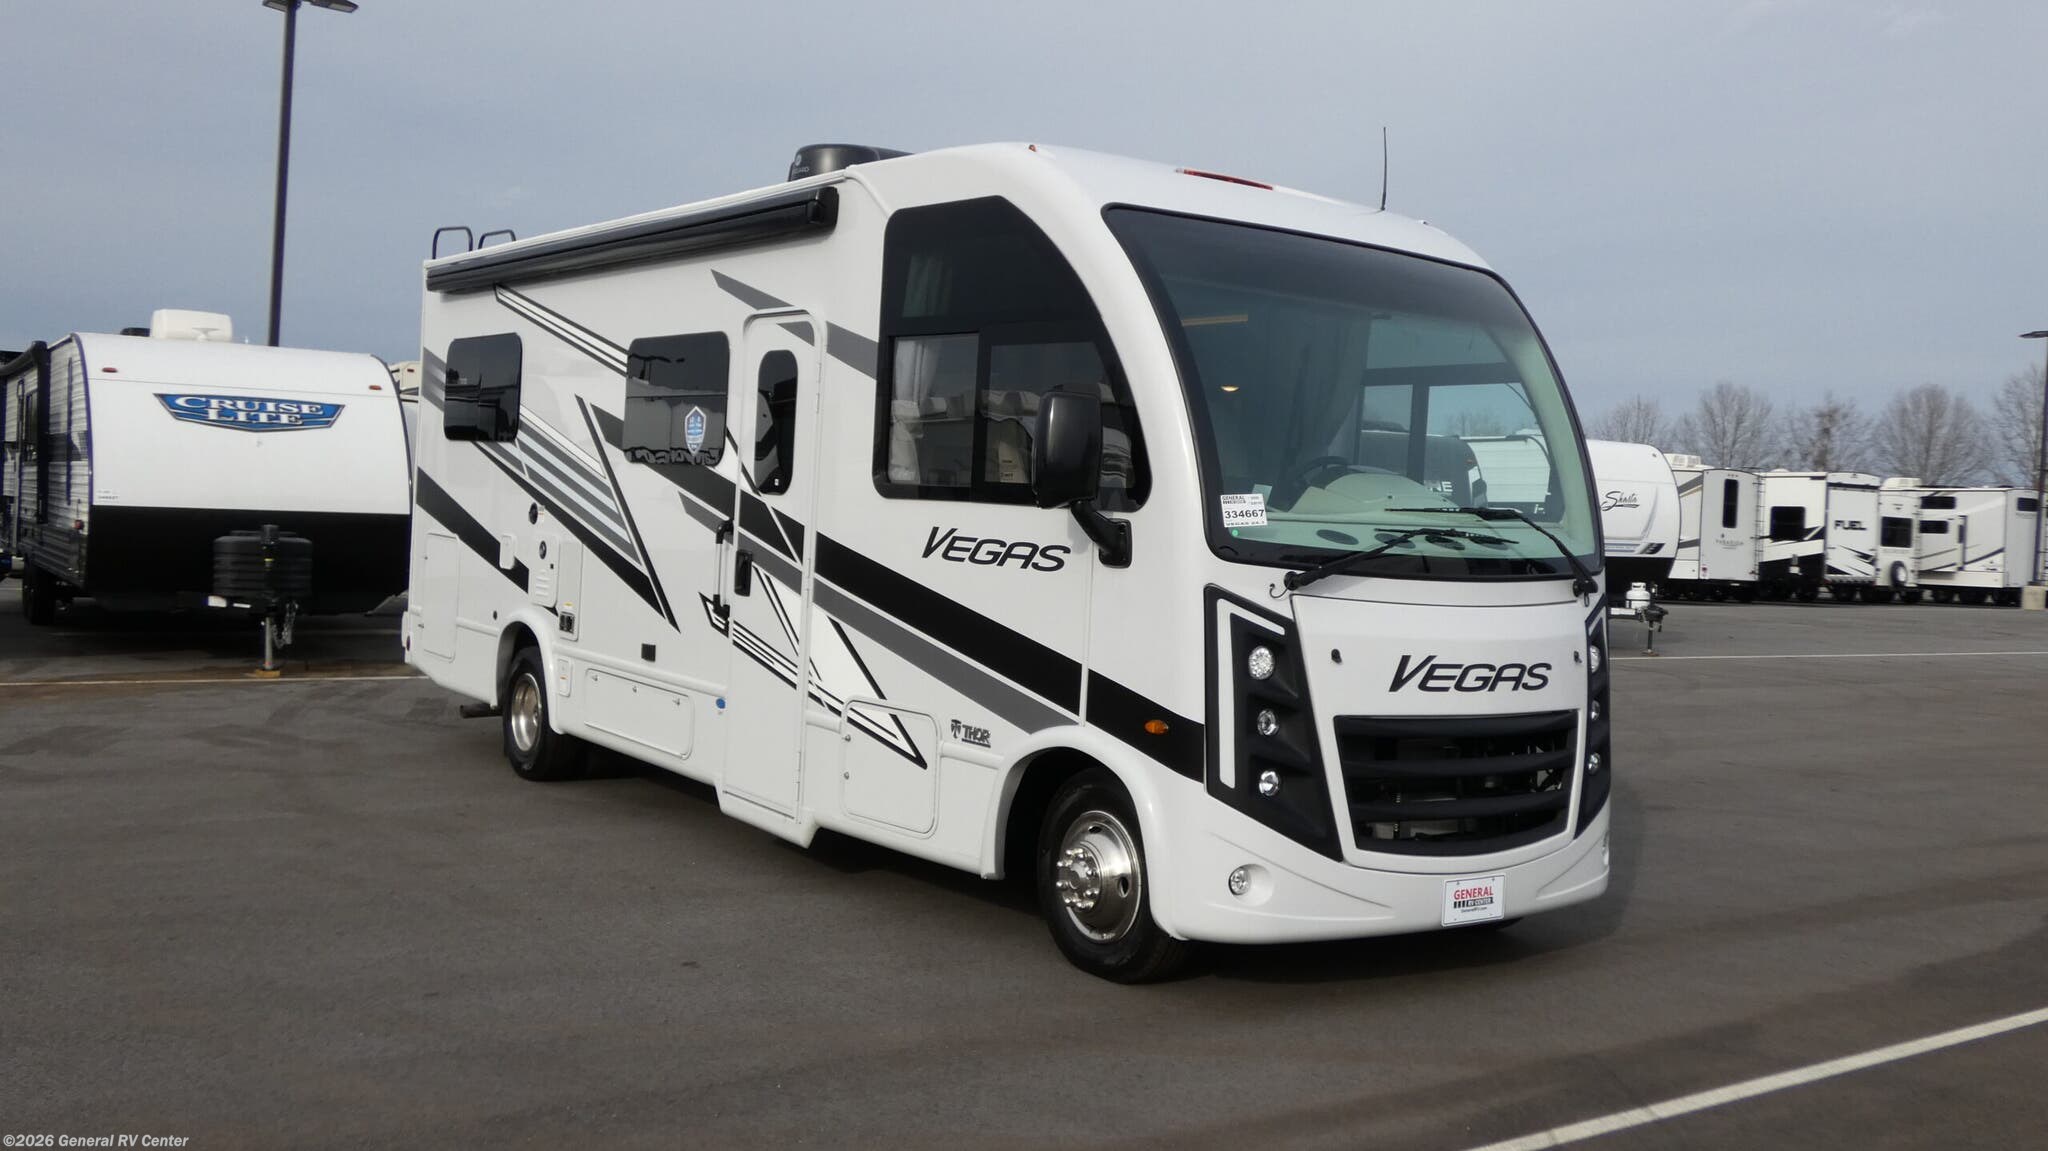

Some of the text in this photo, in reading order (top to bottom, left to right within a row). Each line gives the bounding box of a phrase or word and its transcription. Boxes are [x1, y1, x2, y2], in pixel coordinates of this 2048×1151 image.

[175, 396, 324, 415] CRUISE
[205, 408, 303, 425] LITE
[1225, 509, 1264, 518] 334667
[1834, 519, 1868, 531] FUEL
[922, 526, 1071, 572] VEGAS
[1389, 654, 1552, 692] VEGAS
[961, 724, 991, 743] THOR
[1453, 886, 1494, 900] GENERAL
